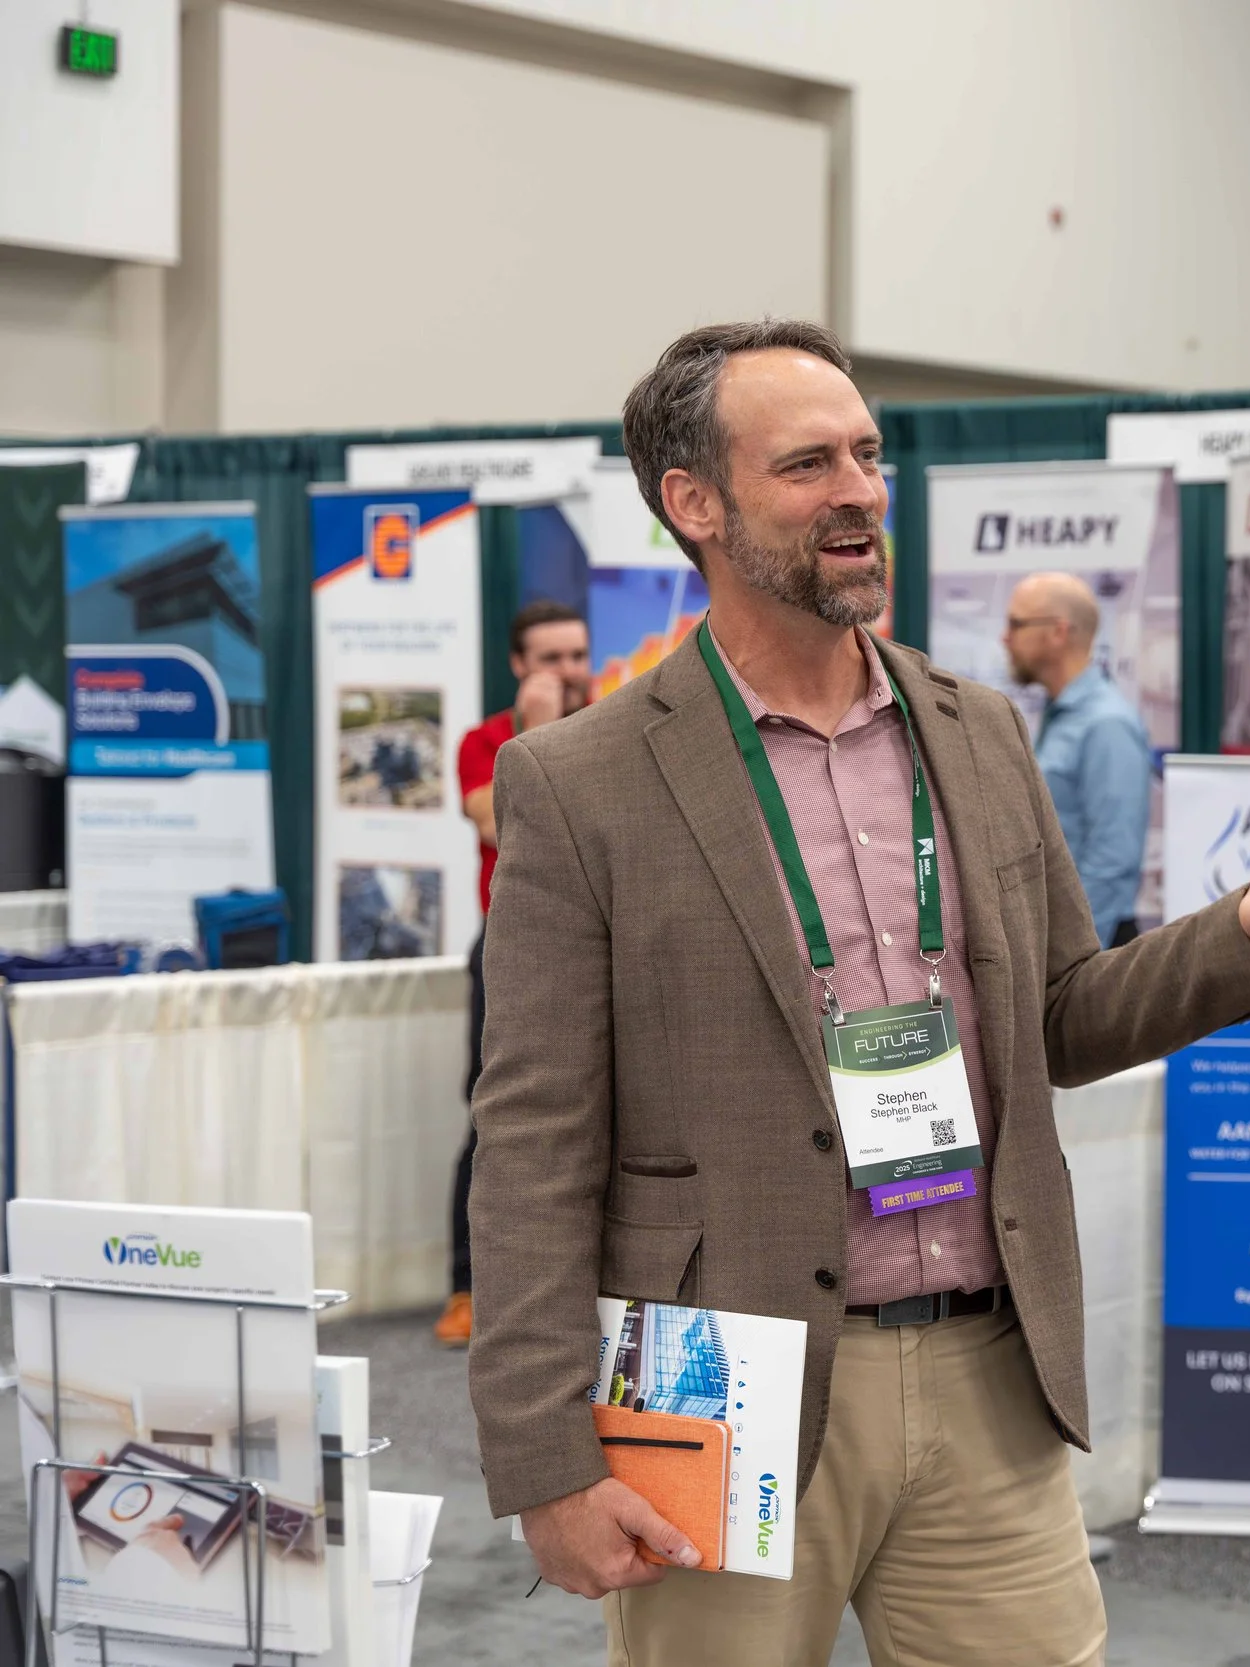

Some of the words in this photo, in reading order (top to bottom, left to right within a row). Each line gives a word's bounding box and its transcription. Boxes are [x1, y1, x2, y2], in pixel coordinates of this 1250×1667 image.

[1016, 515, 1119, 546] HEAPY
[860, 1023, 904, 1036] ENGINEERING
[904, 1021, 918, 1029] THE
[854, 1029, 930, 1053] FUTURE
[876, 1090, 928, 1106] Stephen
[870, 1106, 910, 1119] Stephen
[911, 1102, 939, 1114] Black
[896, 1115, 912, 1124] MHP
[859, 1147, 884, 1155] Attendee
[895, 1164, 911, 1173] 2025
[912, 1159, 943, 1170] Engineering
[881, 1194, 904, 1209] FIRST
[905, 1189, 926, 1204] TIME
[926, 1181, 965, 1200] ATTENDEE
[103, 1236, 202, 1268] OneVue
[1186, 1349, 1219, 1371] LET
[1220, 1350, 1247, 1371] US
[1210, 1372, 1242, 1394] ON
[757, 1472, 778, 1558] OneVue
